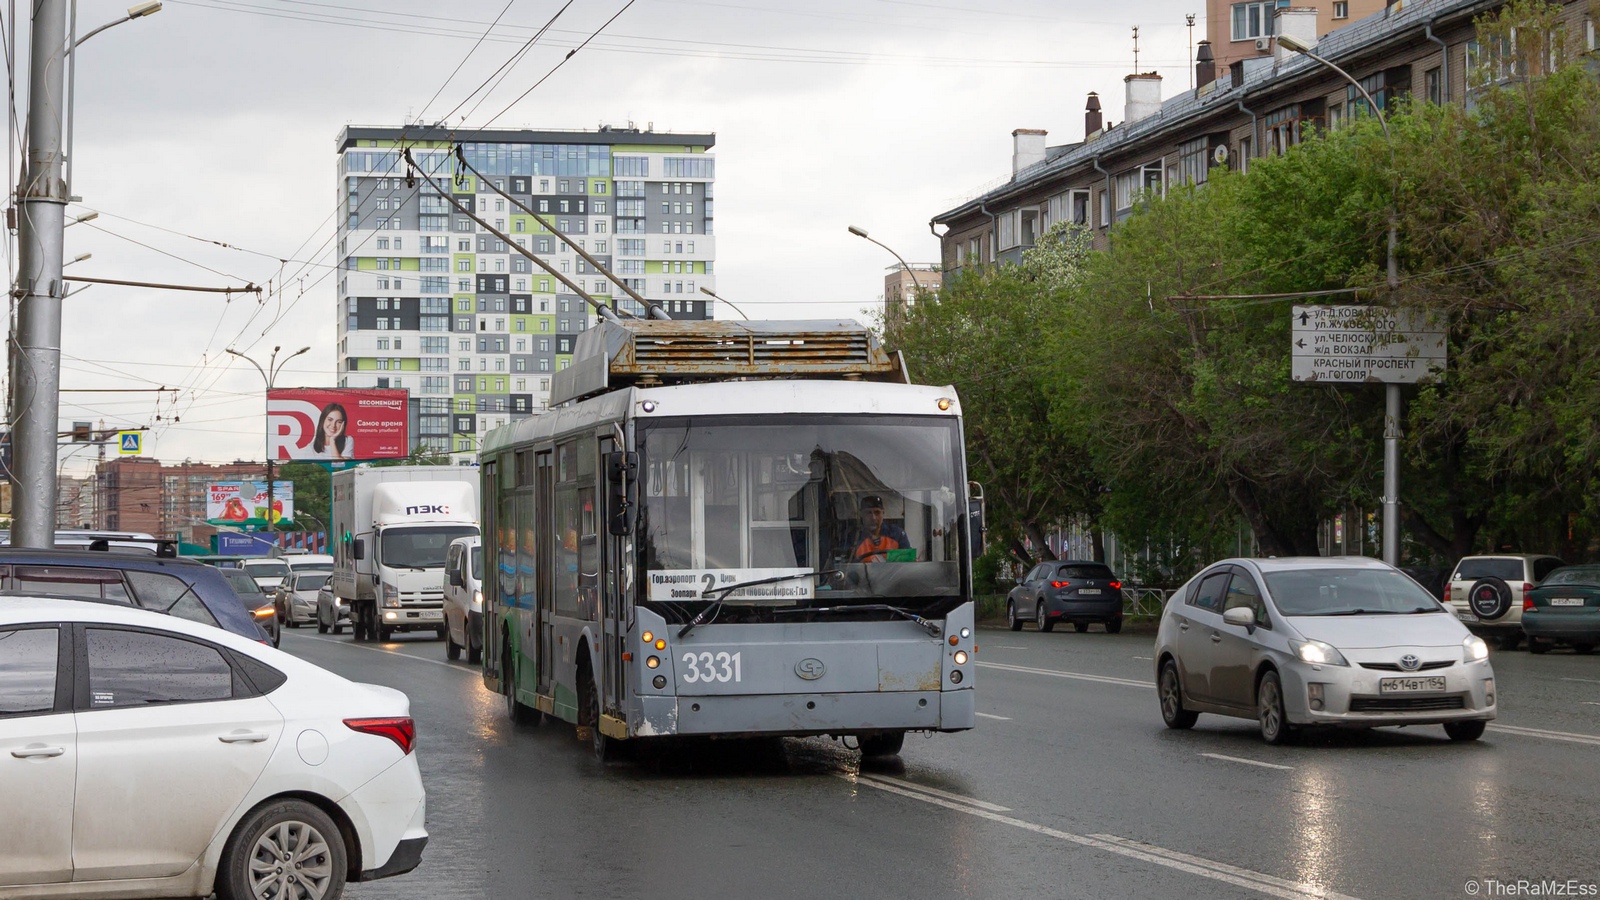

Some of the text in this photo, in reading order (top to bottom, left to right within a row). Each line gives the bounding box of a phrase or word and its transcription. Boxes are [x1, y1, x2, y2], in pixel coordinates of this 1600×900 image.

[1314, 345, 1373, 355] ж/д ВОКЗАЛ
[1314, 357, 1416, 369] КРАСНЫЙ ПРОСПЕКТ
[1315, 370, 1367, 380] ул.ГОГОЛЯ
[356, 419, 379, 427] Самое
[652, 573, 736, 599] Гор.аэропорт 2 Цирк
[671, 589, 697, 599] Зоопарк
[682, 651, 741, 684] 3331
